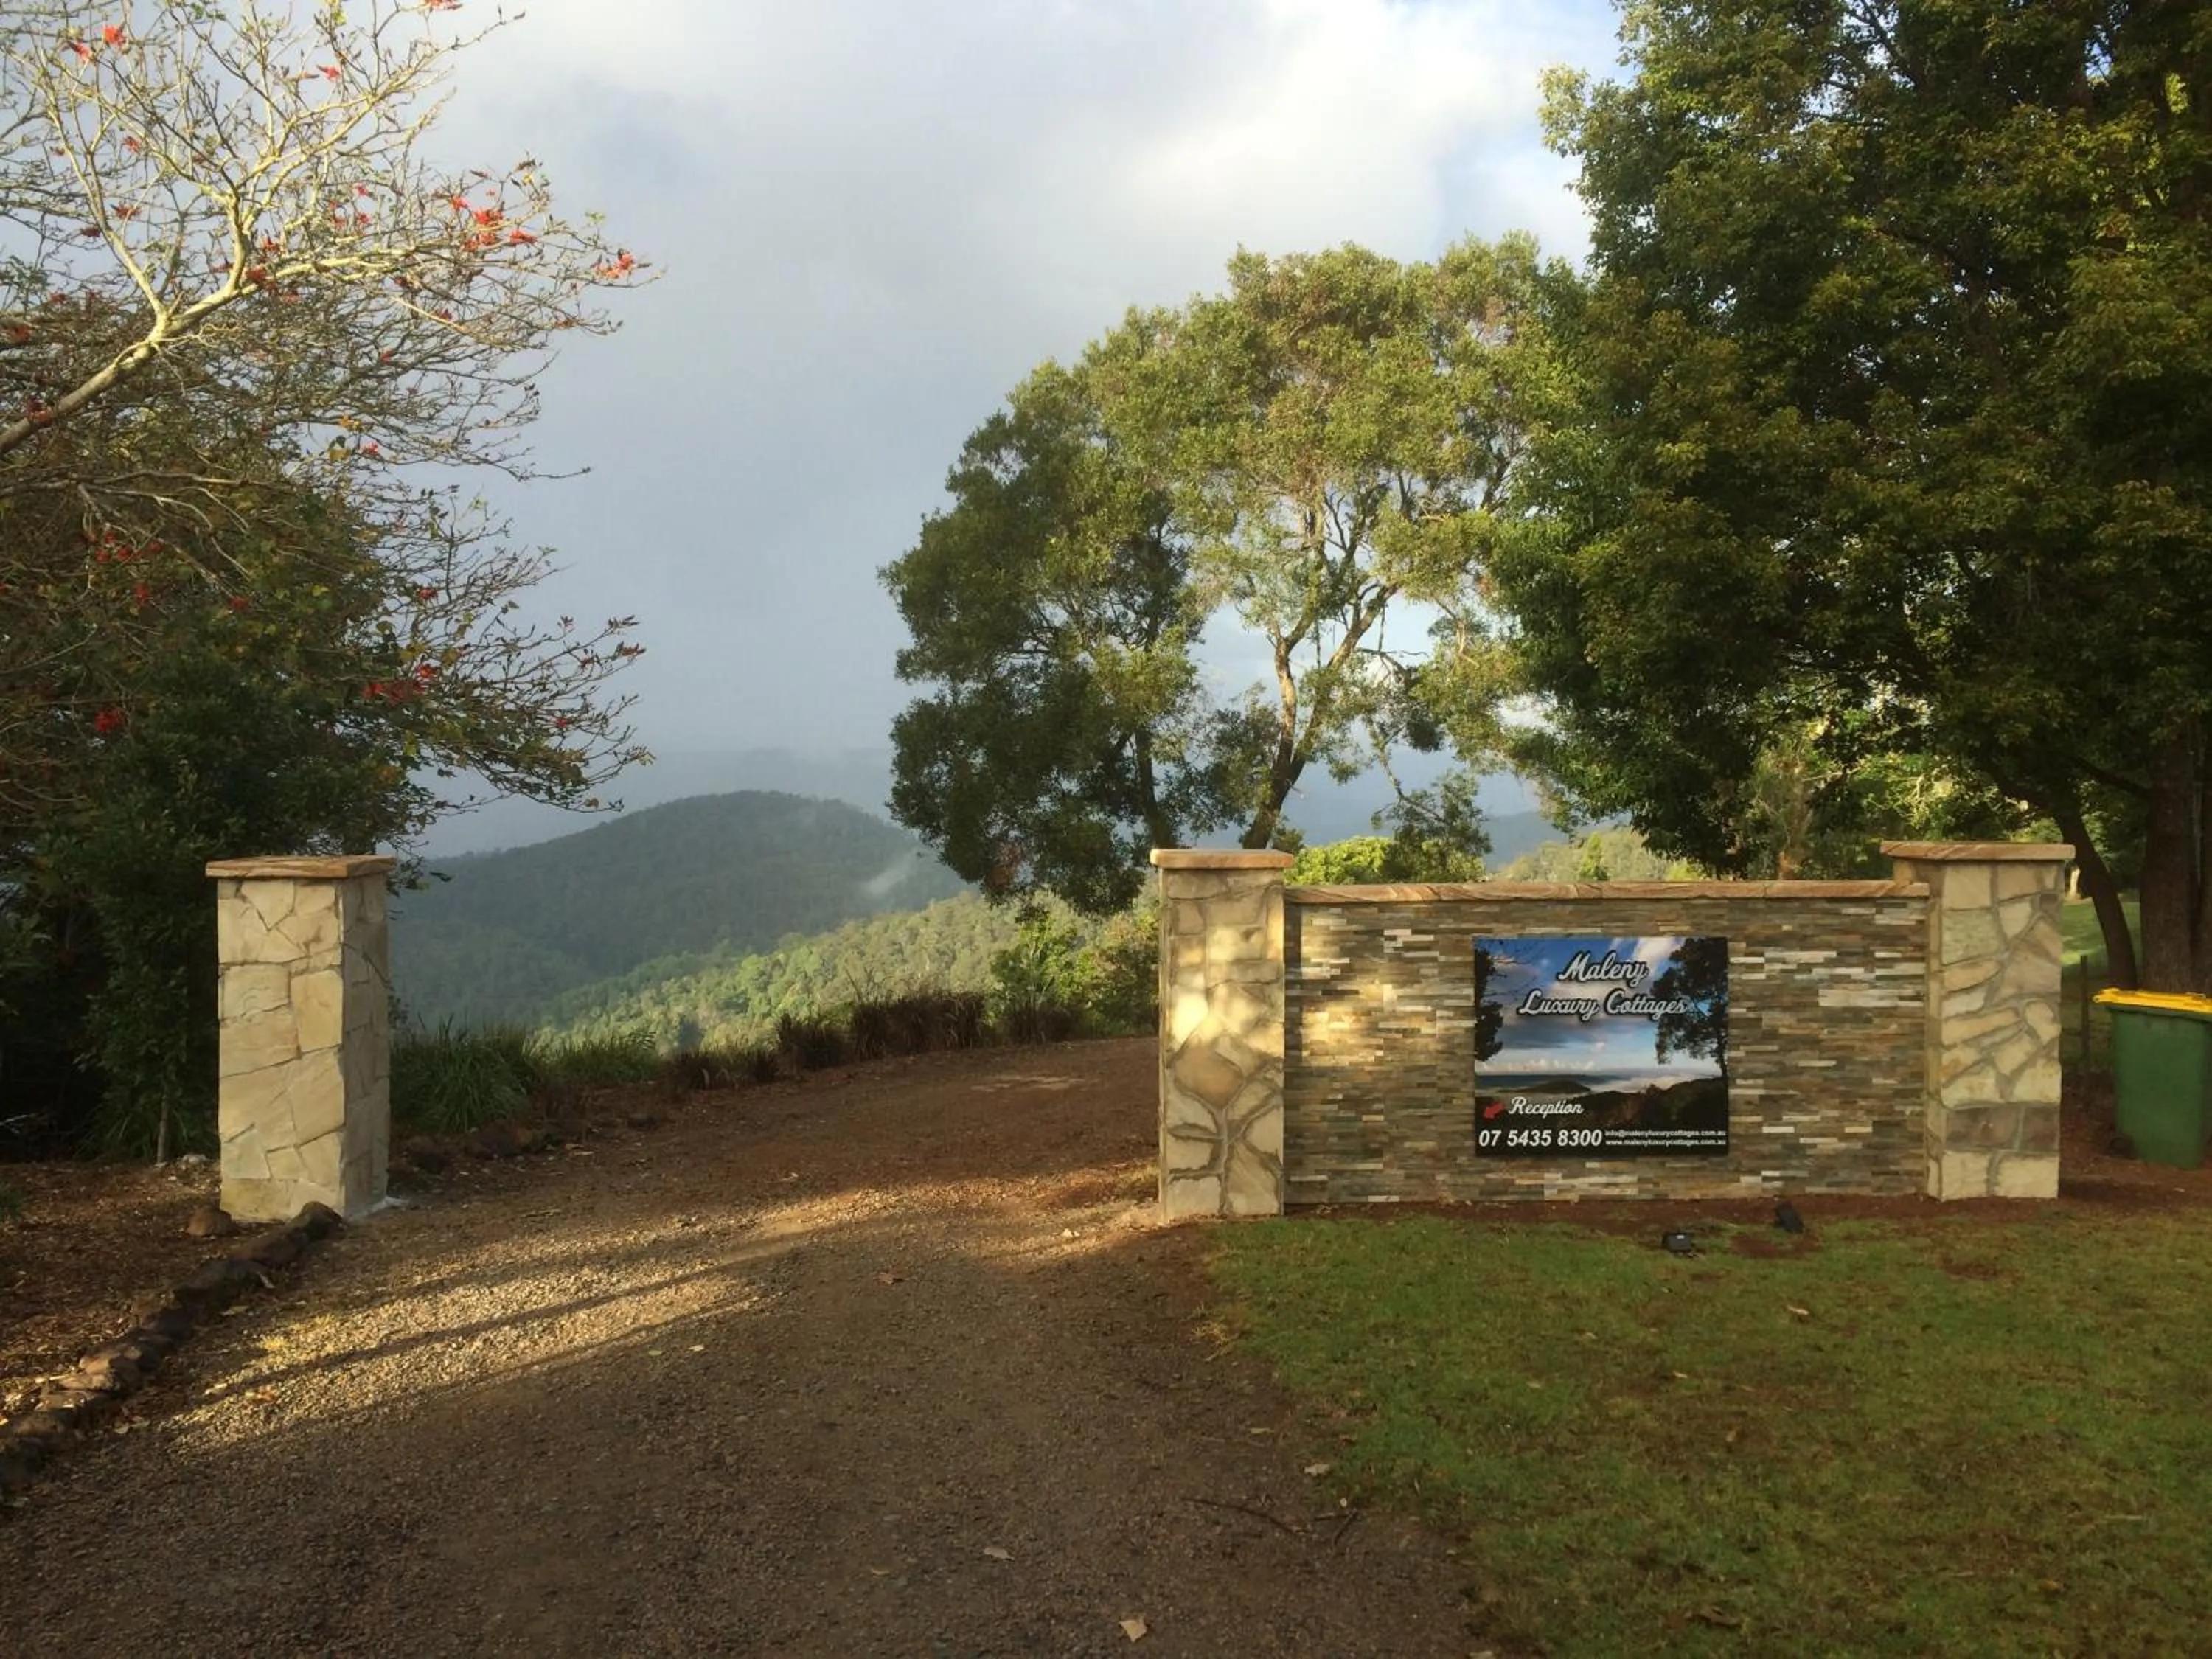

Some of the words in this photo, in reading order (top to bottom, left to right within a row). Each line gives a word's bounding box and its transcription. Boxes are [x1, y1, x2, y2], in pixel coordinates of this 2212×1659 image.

[1558, 952, 1649, 987] Maleny
[1519, 990, 1599, 1020] Luxury
[1606, 990, 1688, 1020] Cottages
[1509, 1096, 1585, 1118] Reception
[1478, 1130, 1501, 1147] 07
[1507, 1130, 1552, 1147] 5435
[1557, 1130, 1602, 1147] 8300
